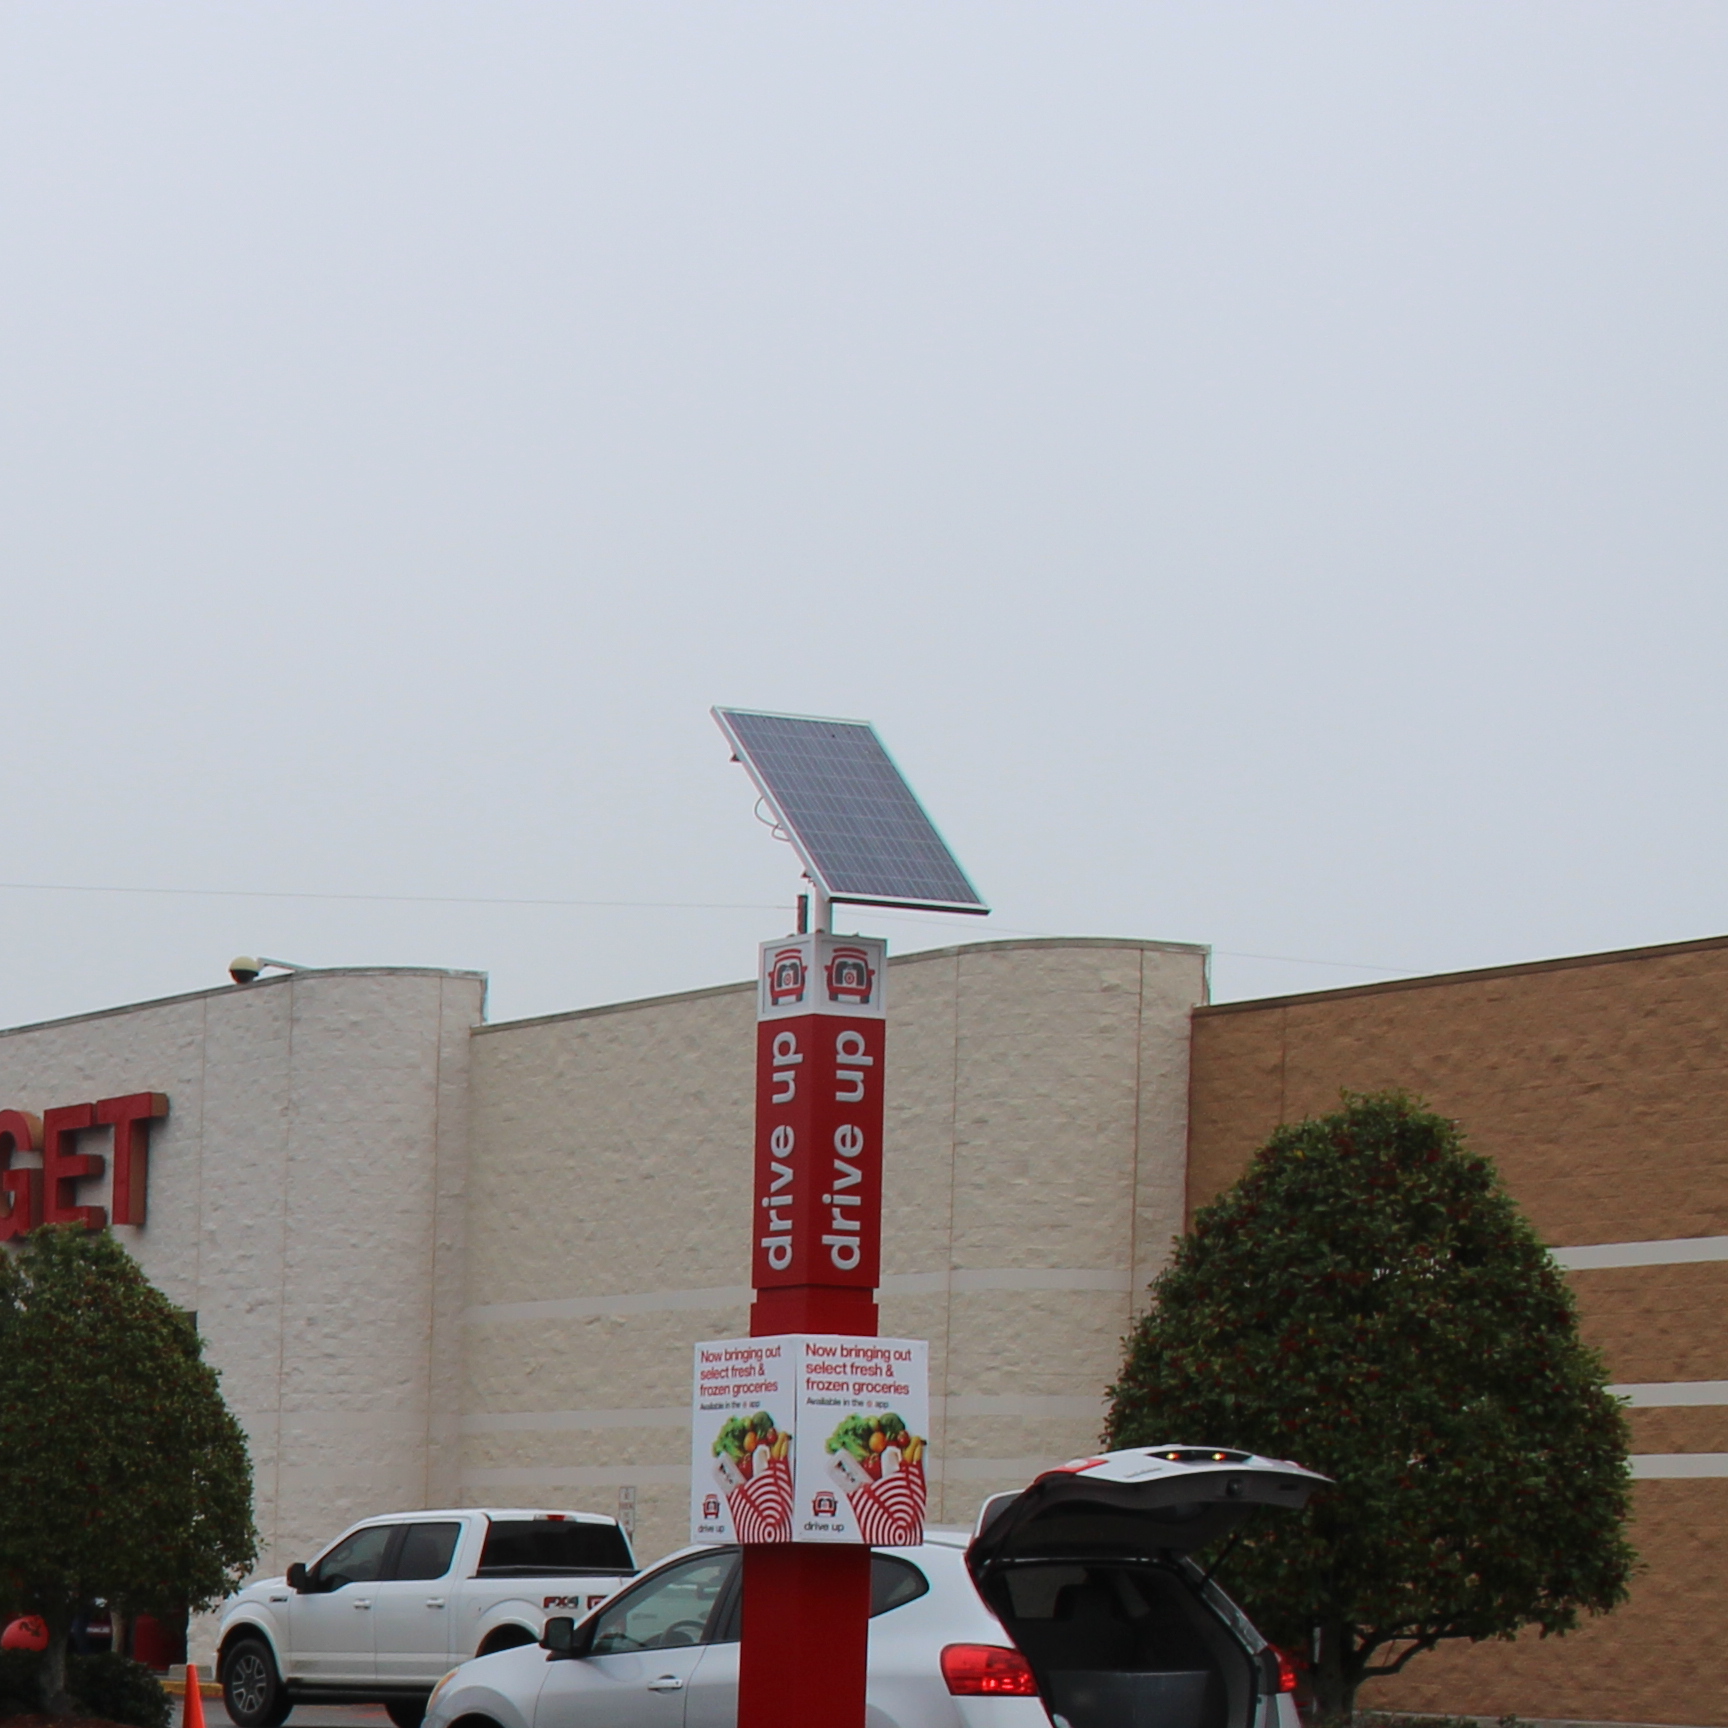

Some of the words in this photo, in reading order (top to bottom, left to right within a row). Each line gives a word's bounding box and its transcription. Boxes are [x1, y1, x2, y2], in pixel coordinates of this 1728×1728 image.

[772, 1031, 804, 1104] up
[835, 1030, 874, 1103] up
[761, 1124, 795, 1271] drive
[821, 1123, 865, 1271] drive
[701, 1350, 722, 1363] Now
[724, 1346, 763, 1363] bringing
[765, 1345, 781, 1358] out
[805, 1343, 836, 1357] Now
[840, 1344, 890, 1363] bringing
[893, 1348, 911, 1361] out
[700, 1366, 730, 1381] select
[731, 1364, 756, 1379] fresh
[757, 1363, 765, 1376] &
[805, 1361, 848, 1375] select
[850, 1362, 883, 1376] fresh
[885, 1364, 894, 1377] &
[700, 1382, 730, 1396] frozen
[732, 1379, 778, 1397] groceries
[805, 1377, 852, 1392] frozen
[853, 1379, 910, 1396] groceries
[806, 1397, 842, 1406] Available
[843, 1398, 850, 1406] in
[852, 1398, 865, 1407] the
[875, 1401, 889, 1409] app
[697, 1524, 715, 1533] drive
[716, 1526, 724, 1534] up
[803, 1522, 830, 1531] drive
[831, 1523, 845, 1533] up
[544, 1596, 579, 1609] FX4
